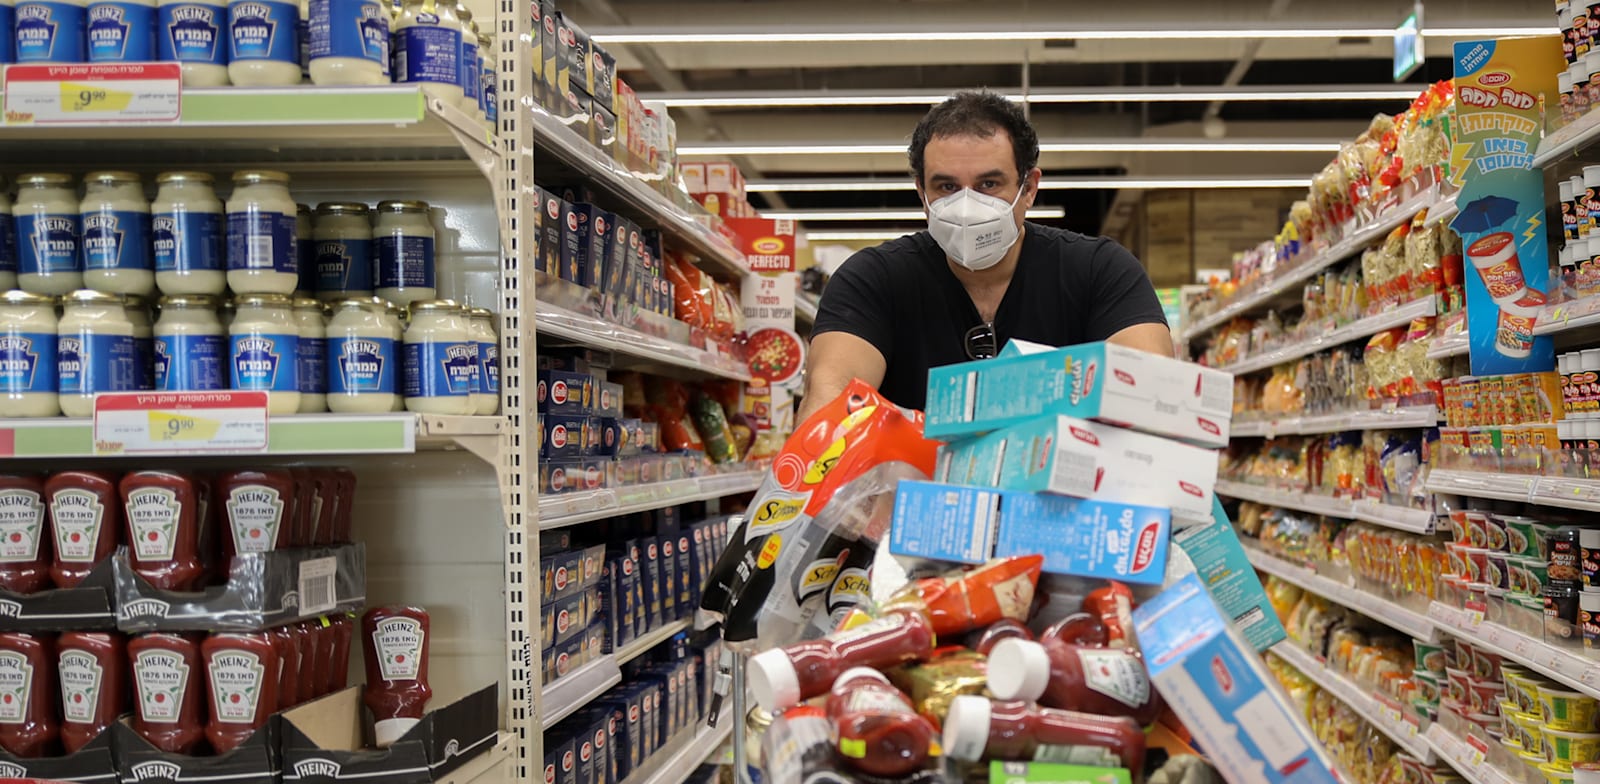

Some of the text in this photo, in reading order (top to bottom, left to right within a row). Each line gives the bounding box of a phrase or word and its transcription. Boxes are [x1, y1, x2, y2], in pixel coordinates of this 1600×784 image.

[90, 7, 121, 20] HEINZ
[175, 8, 211, 22] HEINZ
[234, 6, 267, 19] HEINZ
[18, 28, 48, 39] ממרח
[91, 29, 121, 40] ממרח
[175, 30, 211, 41] ממרח
[235, 26, 268, 38] ממרח
[1460, 43, 1484, 66] מהדורה
[1464, 49, 1489, 73] מיוחדת!
[1488, 75, 1505, 83] אסם
[1460, 87, 1535, 109] מנה חמה
[1459, 112, 1537, 136] מוקרמת!
[1484, 138, 1528, 154] בואו
[1476, 154, 1535, 175] לטעום!
[37, 219, 72, 233] HEINZ
[84, 216, 115, 229] HEINZ
[153, 219, 175, 233] EINZ
[39, 240, 75, 250] ממרח
[86, 237, 116, 249] ממרח
[749, 255, 790, 269] PERFECTO
[239, 339, 272, 352] HEINZ
[343, 342, 378, 356] HEINZ
[239, 360, 271, 371] ממרח
[345, 363, 378, 373] ממרח
[60, 495, 89, 507] HEINZ
[136, 494, 166, 506] HEINZ
[238, 493, 270, 504] HEINZ
[18, 511, 36, 519] מאז
[1115, 509, 1134, 575] קורנפלקס
[1138, 529, 1154, 565] תלמה
[129, 603, 166, 617] HEINZ
[385, 623, 413, 633] HEINZ
[65, 657, 90, 669] HEINZ
[144, 656, 176, 668] HEINZ
[220, 657, 250, 669] HEINZ
[64, 672, 94, 681] מאז 1876
[142, 671, 179, 680] מאז 1876
[217, 672, 235, 680] 1876
[138, 766, 176, 779] HEINZ
[300, 764, 336, 777] HEINZ
